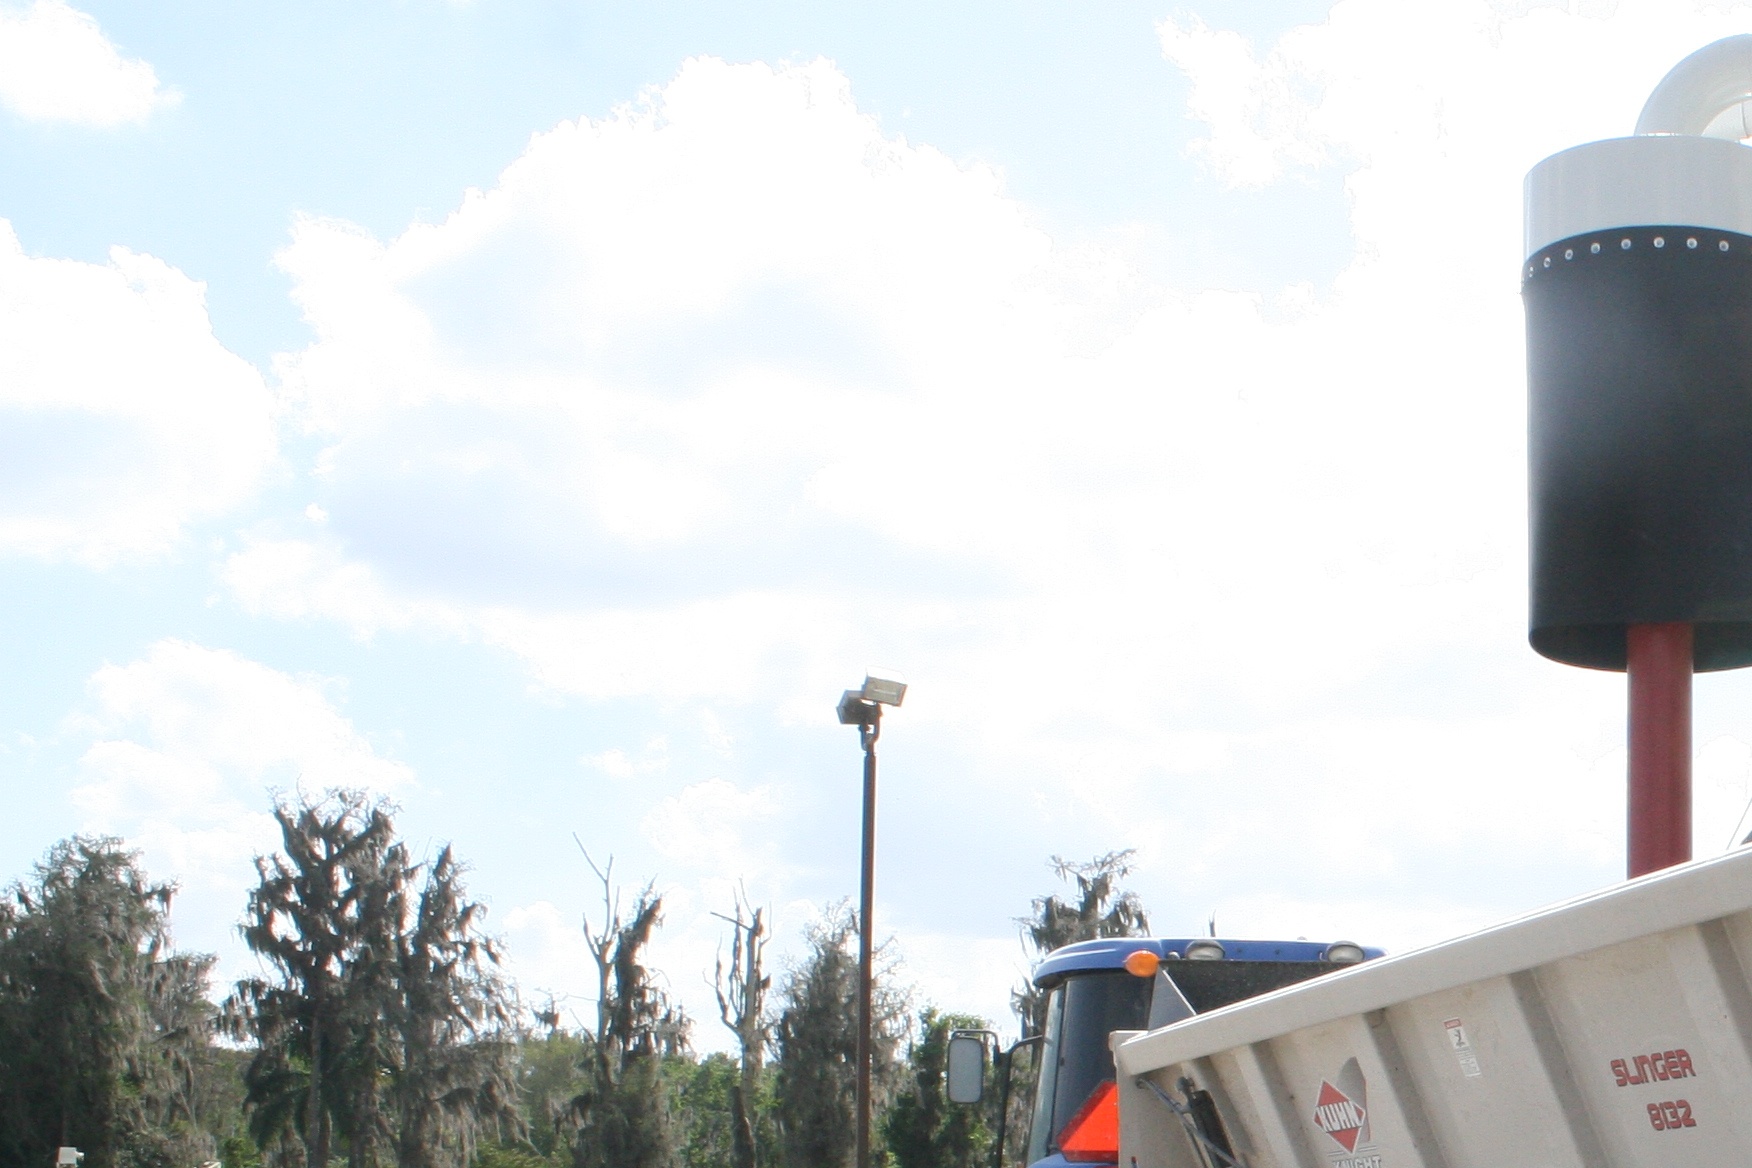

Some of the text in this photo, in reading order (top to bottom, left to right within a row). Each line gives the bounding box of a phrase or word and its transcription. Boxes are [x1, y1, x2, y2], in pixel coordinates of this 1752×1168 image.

[1610, 1049, 1697, 1088] SLINGER
[1316, 1100, 1362, 1133] KUHN
[1646, 1099, 1697, 1132] 8132
